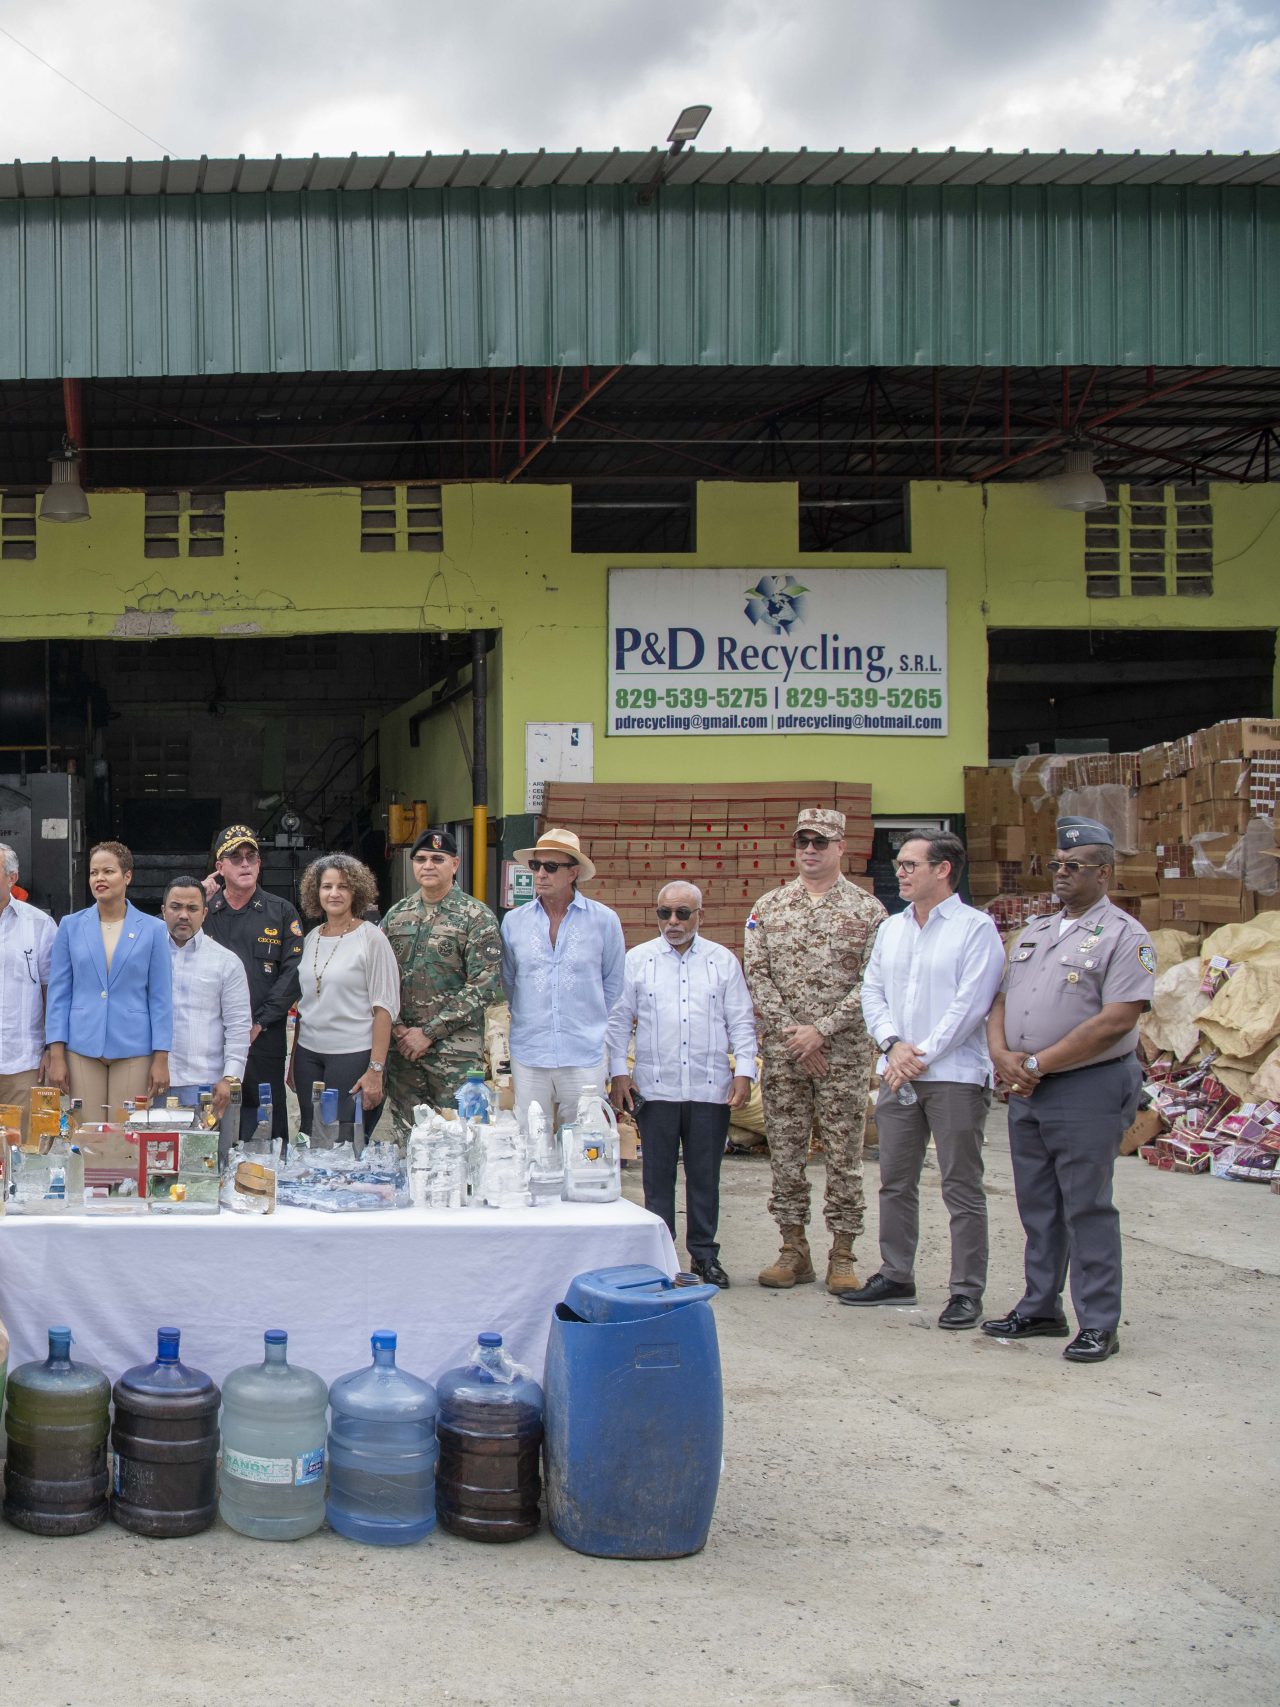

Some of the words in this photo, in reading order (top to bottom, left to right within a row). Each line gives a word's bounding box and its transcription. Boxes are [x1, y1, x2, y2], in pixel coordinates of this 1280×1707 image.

[615, 627, 705, 671] P&D
[717, 633, 894, 683] Recycling,
[899, 654, 943, 672] S.R.L.
[615, 687, 768, 709] 829-539-5275
[785, 687, 943, 709] 829-539-5265
[615, 714, 768, 730] pdrecycling@gmail.com
[777, 714, 942, 730] pdrecycling@hotmail.com
